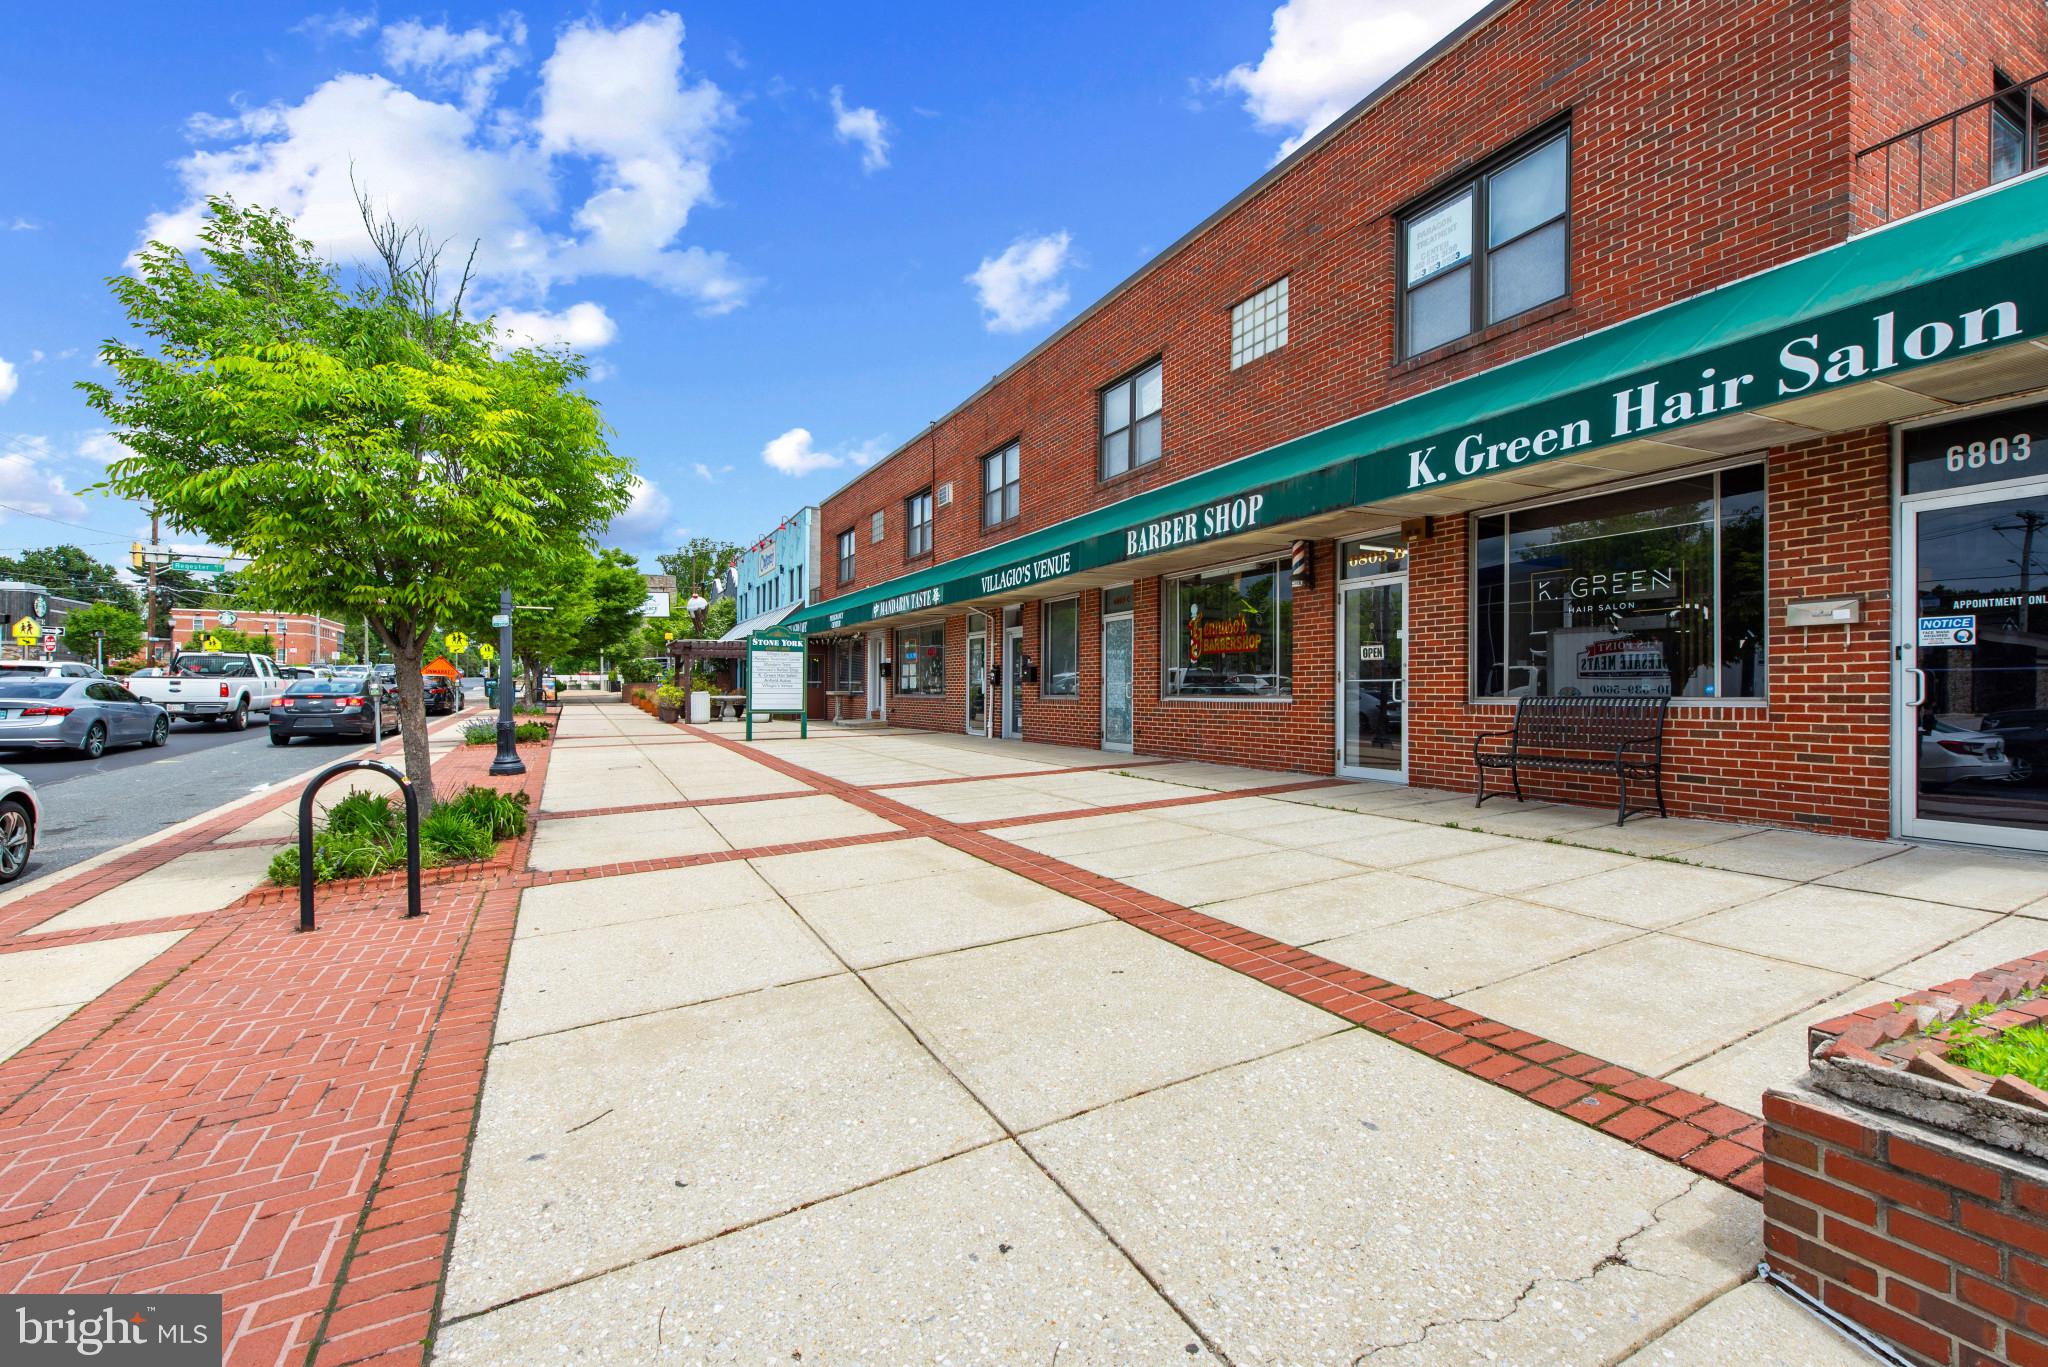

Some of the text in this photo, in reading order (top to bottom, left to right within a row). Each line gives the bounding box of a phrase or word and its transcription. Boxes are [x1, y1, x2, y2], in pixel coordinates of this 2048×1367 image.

[1406, 300, 2024, 490] K. Green Hair Salon
[1945, 432, 2032, 473] 6803
[1127, 494, 1264, 556] BARBER SHOP
[981, 552, 1071, 594] VILLAGIO'S VENUE
[1538, 567, 1672, 601] K. GREEN
[880, 589, 932, 616] MANDARIN TASTE
[1568, 601, 1635, 614] HAIR SALON
[1952, 594, 2048, 610] APPOINTMENT ONL
[1922, 617, 1972, 629] NOTICE
[752, 638, 804, 647] STONE YORK
[1203, 634, 1262, 652] BARBERSHOP
[1362, 646, 1383, 659] OPEN
